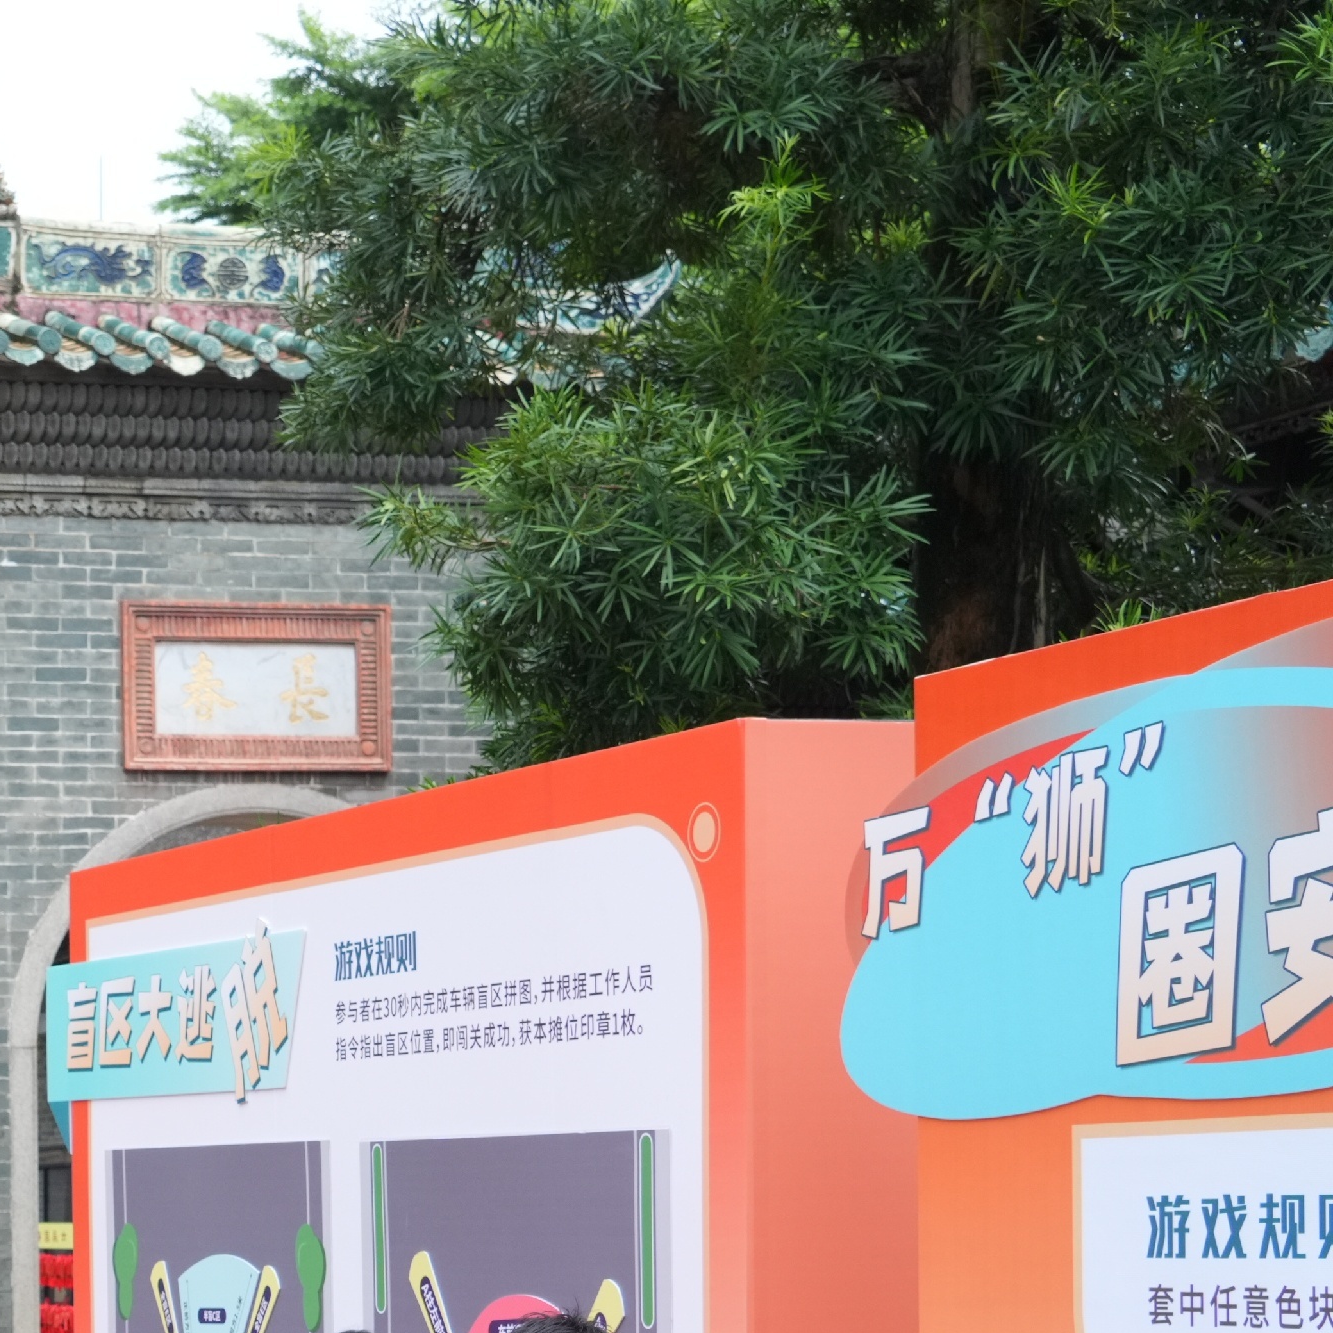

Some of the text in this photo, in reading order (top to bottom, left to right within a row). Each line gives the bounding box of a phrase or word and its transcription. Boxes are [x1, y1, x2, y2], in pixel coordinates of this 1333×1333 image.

[334, 931, 417, 981] 游戏规则
[65, 919, 288, 1103] 盲区大逃脱
[1146, 1193, 1333, 1259] 游戏规
[1148, 1284, 1333, 1330] 套中任意色块
